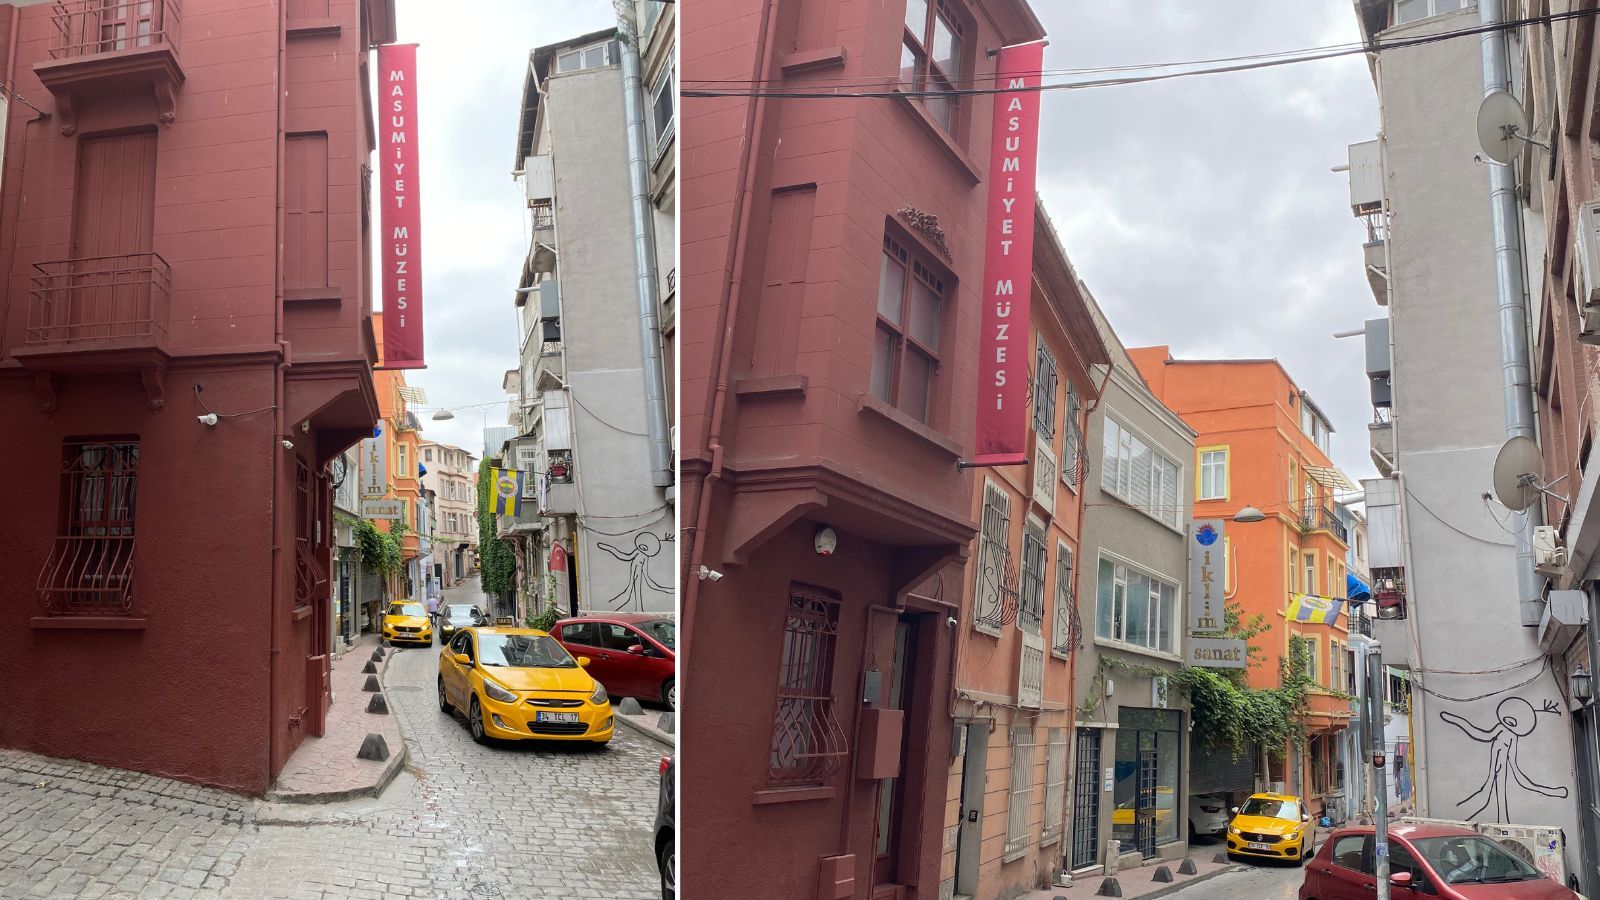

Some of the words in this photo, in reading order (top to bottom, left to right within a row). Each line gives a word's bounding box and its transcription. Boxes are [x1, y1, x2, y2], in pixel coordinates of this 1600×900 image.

[365, 504, 399, 515] sanat
[1197, 551, 1217, 628] iklim
[1193, 647, 1241, 662] sanat
